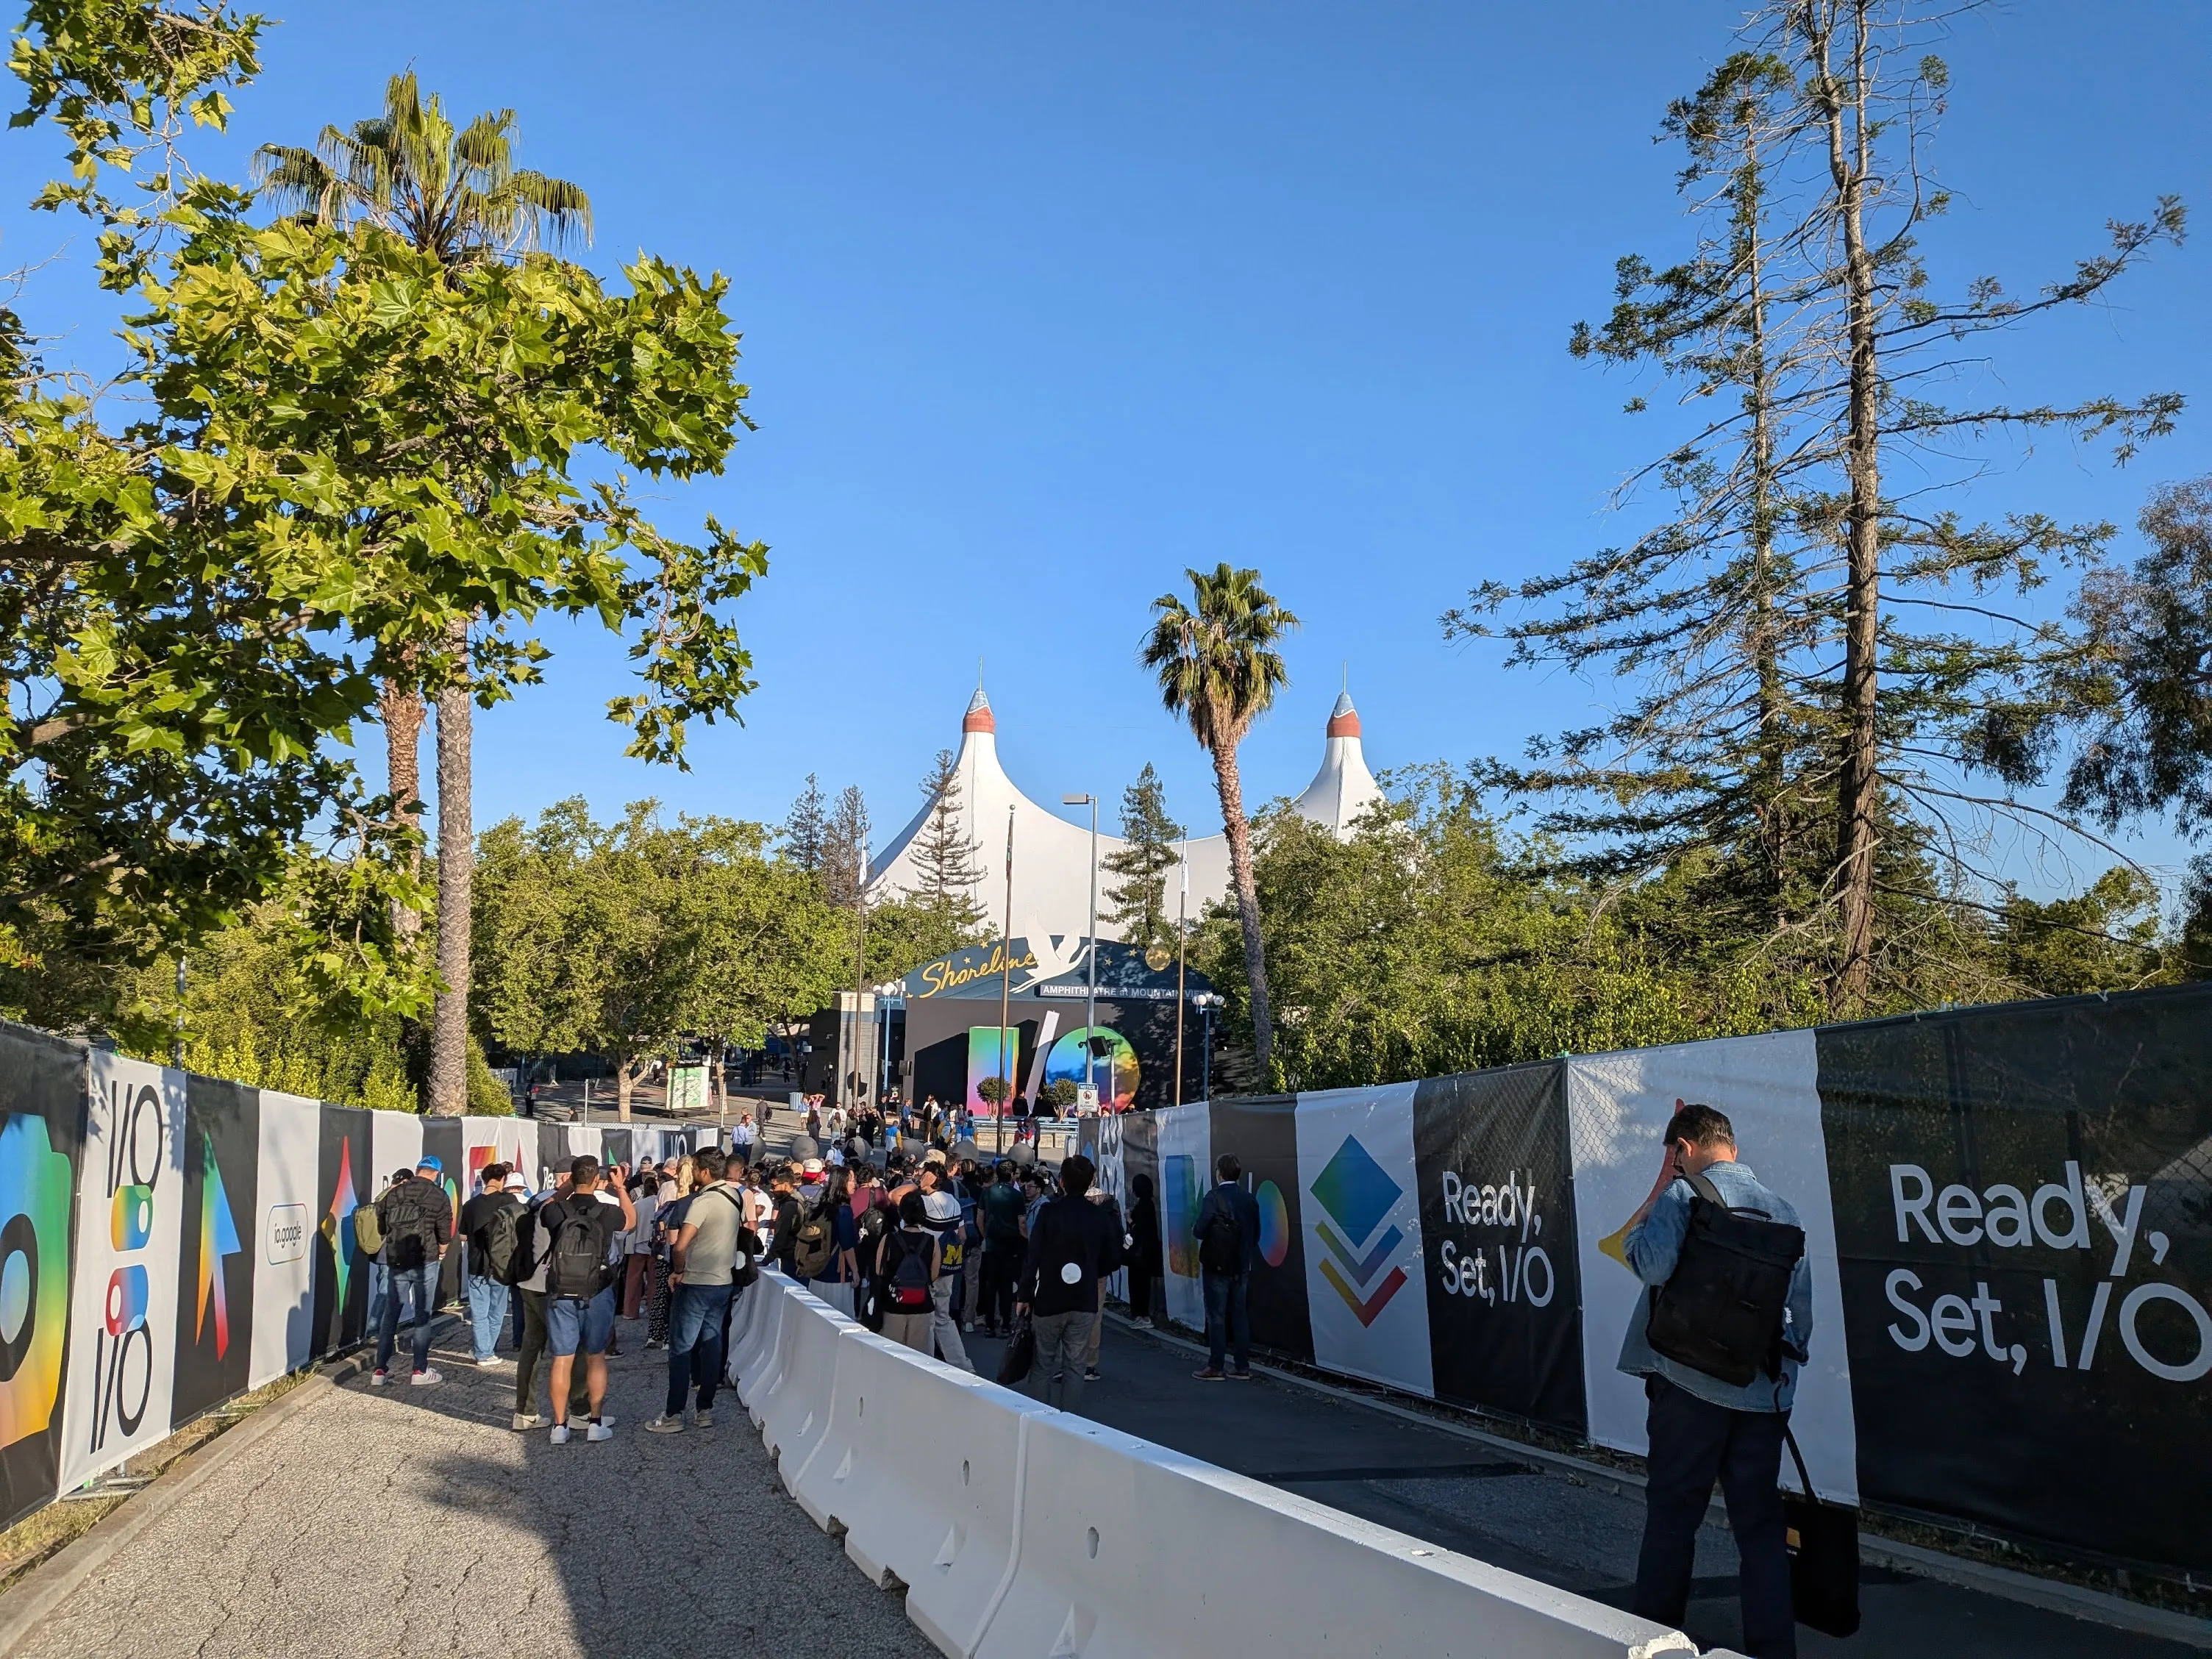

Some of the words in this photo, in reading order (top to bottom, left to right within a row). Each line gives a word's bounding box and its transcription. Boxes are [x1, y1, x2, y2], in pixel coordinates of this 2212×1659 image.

[1043, 985, 1117, 996] AMPHITHATRE
[1119, 987, 1128, 996] at
[274, 1221, 302, 1249] io.google
[1442, 1170, 1542, 1244] Ready,
[1889, 1160, 2170, 1277] Ready,
[942, 1244, 963, 1265] M
[1441, 1239, 1496, 1308] Set,
[1499, 1244, 1555, 1307] I/O
[1885, 1268, 2027, 1377] Set,
[2043, 1278, 2212, 1382] I/O
